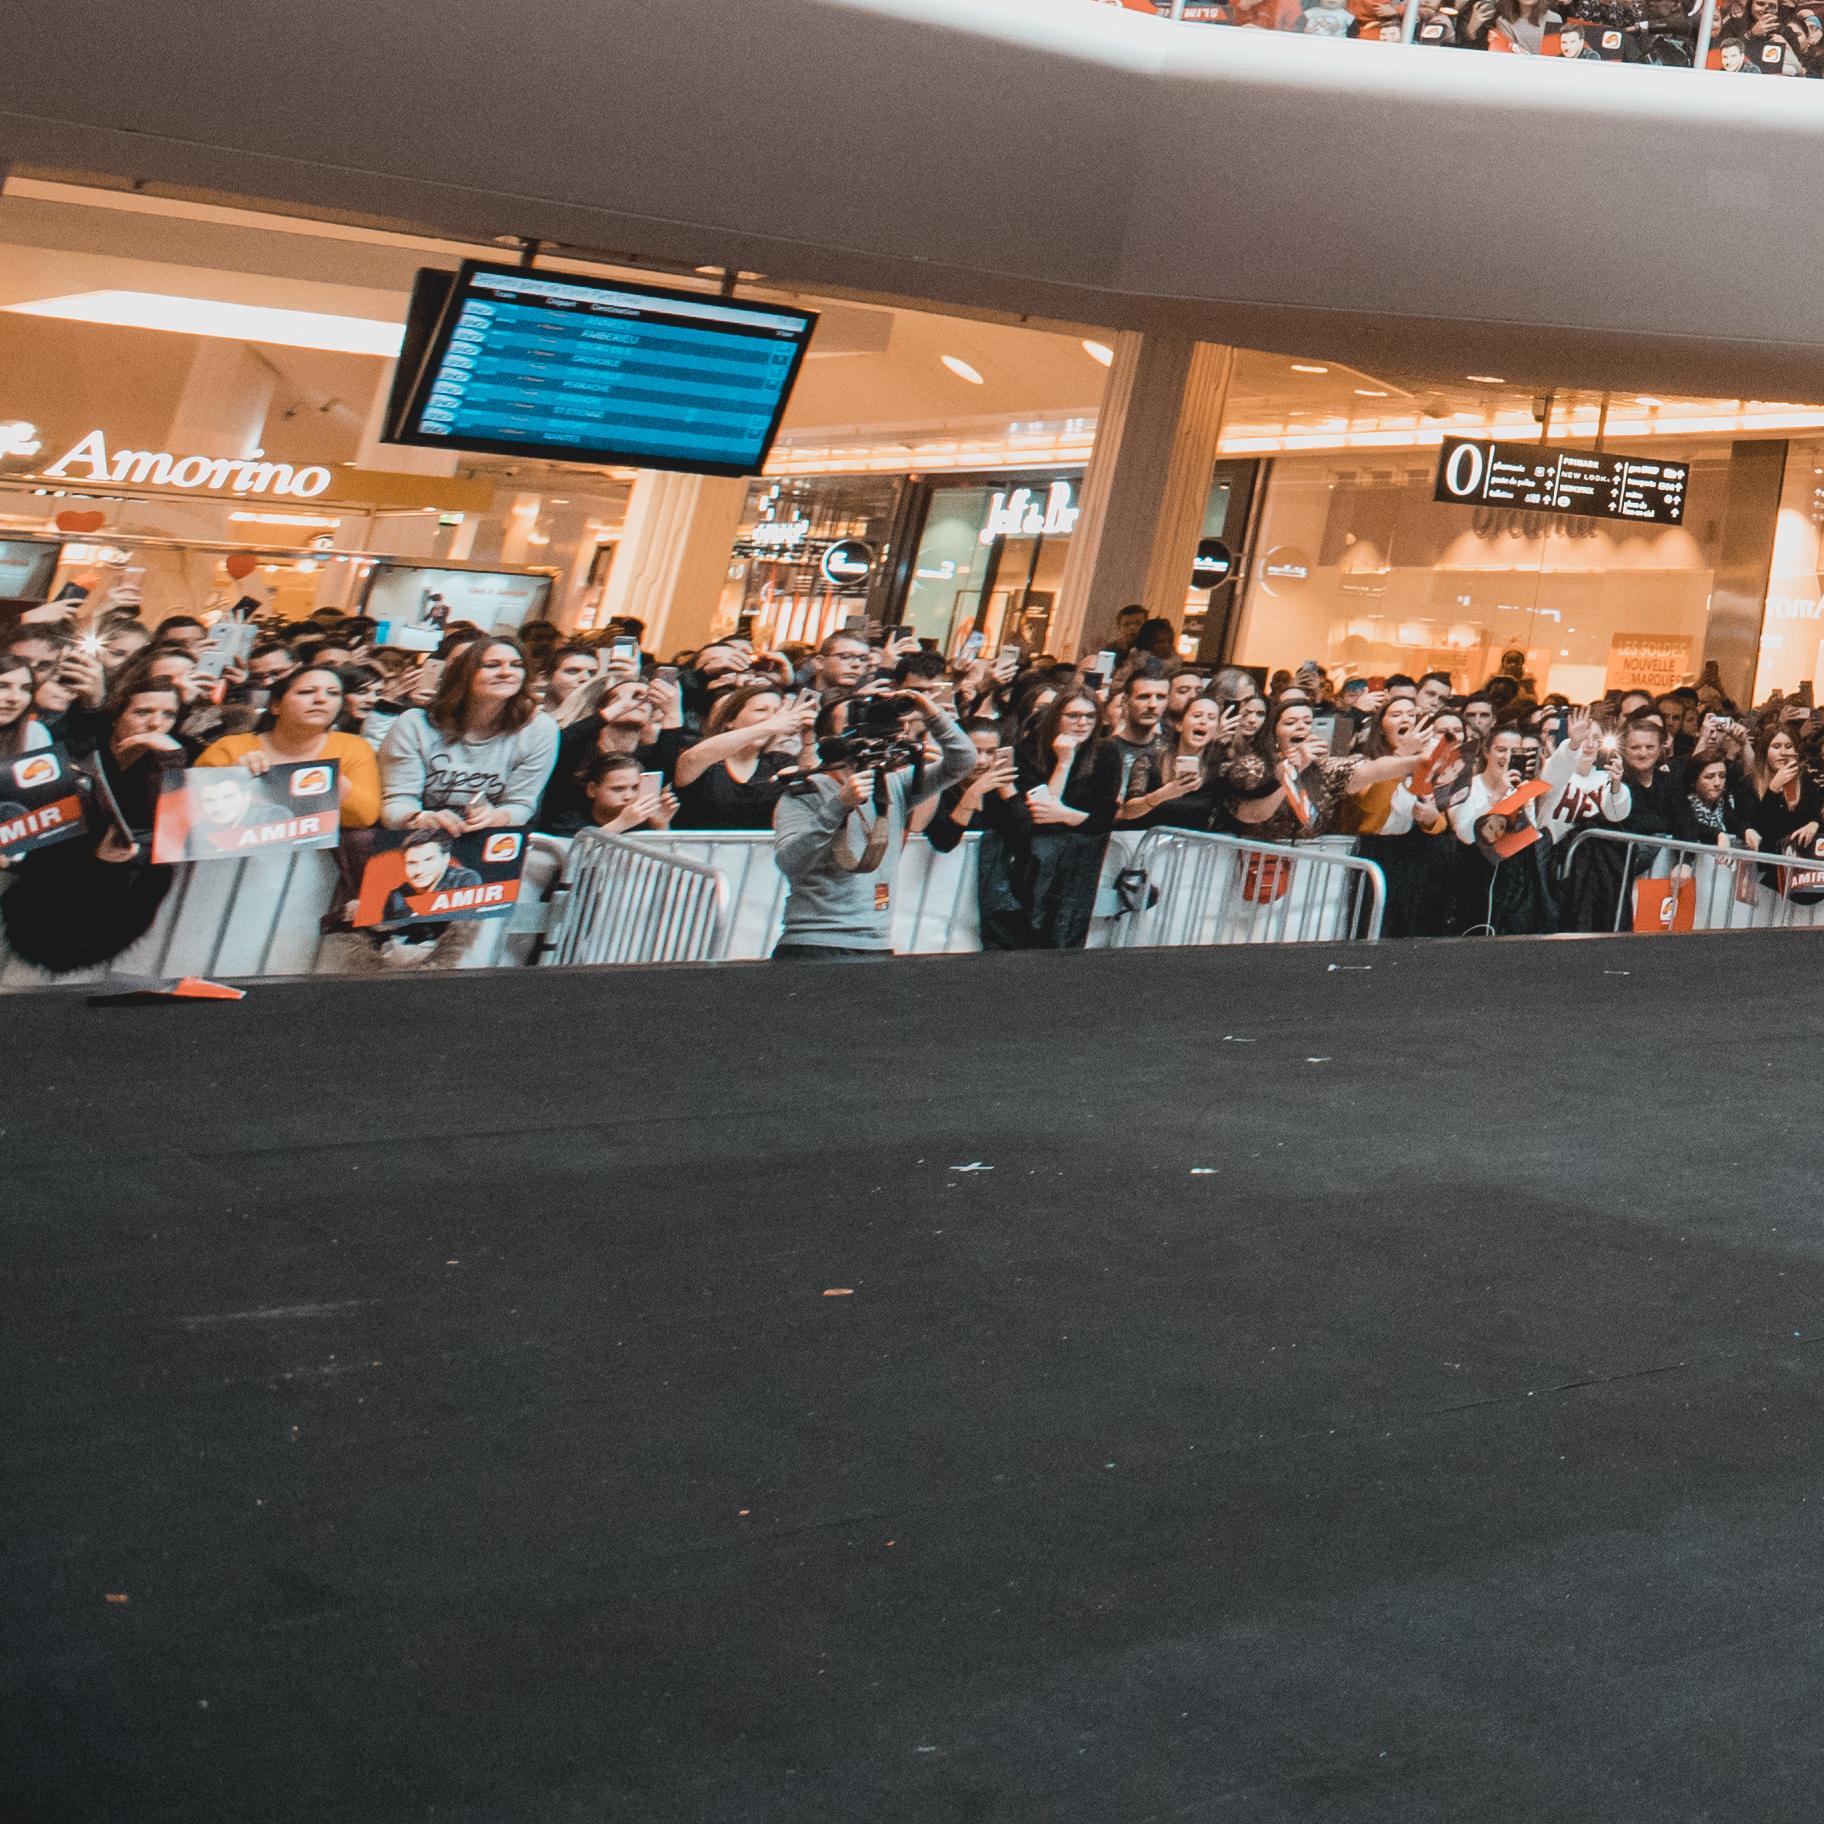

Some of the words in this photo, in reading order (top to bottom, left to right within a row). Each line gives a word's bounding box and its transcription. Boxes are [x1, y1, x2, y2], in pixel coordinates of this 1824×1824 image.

[43, 430, 331, 497] Amorino
[1561, 471, 1582, 480] NEW
[1623, 658, 1676, 672] NOUVELLE
[0, 806, 62, 844] MIR
[238, 817, 320, 847] AMIR
[430, 884, 505, 912] AMIR
